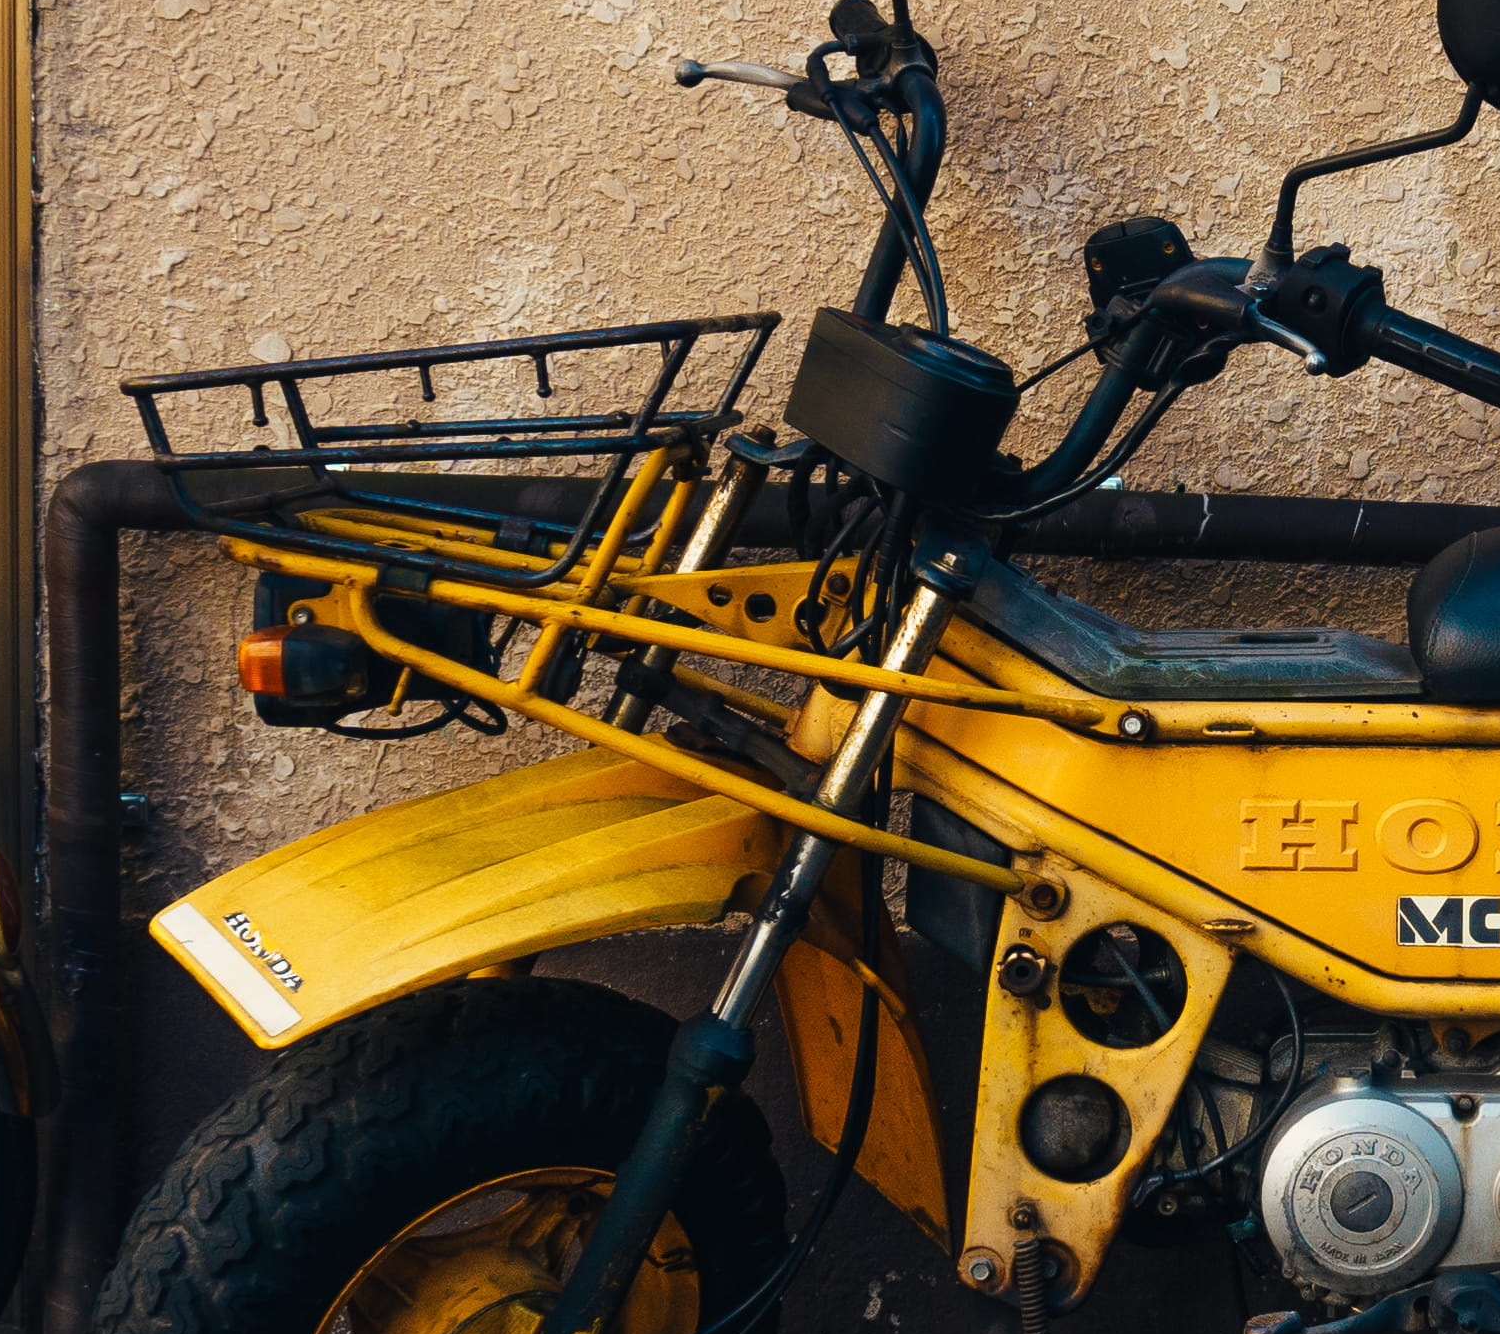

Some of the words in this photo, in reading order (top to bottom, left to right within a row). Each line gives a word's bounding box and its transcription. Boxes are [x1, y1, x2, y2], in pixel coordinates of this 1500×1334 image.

[1298, 1136, 1426, 1196] HONDA
[1319, 1241, 1350, 1263] MADE
[1353, 1253, 1368, 1265] IN
[1372, 1242, 1406, 1264] JAPAN
